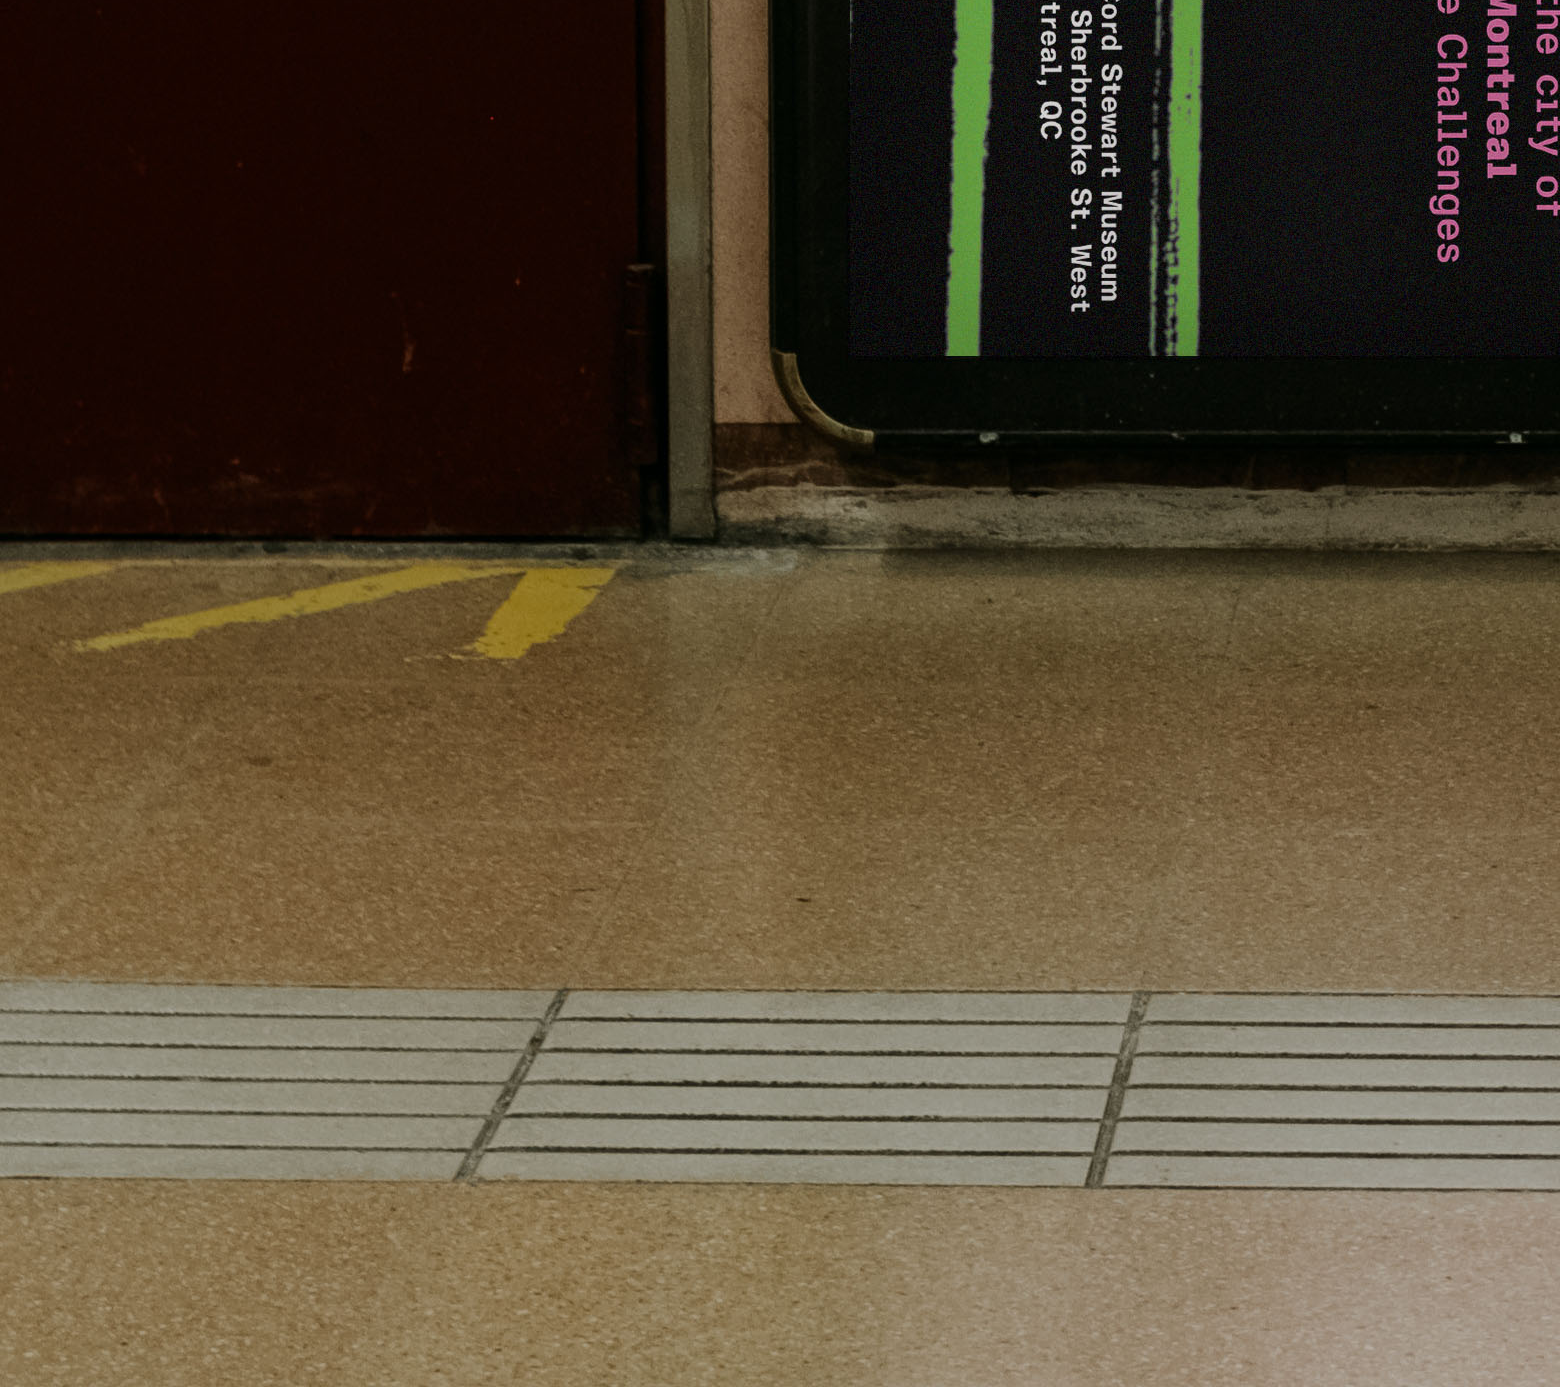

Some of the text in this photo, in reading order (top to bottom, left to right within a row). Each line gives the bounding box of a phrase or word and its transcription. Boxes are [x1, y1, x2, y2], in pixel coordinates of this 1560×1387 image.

[1037, 100, 1064, 140] QC
[1069, 10, 1094, 176] Sherbrooke
[1100, 63, 1124, 178] Stewart
[1429, 35, 1470, 263] Challenges
[1069, 188, 1094, 230] St.
[1100, 191, 1124, 302] Museum
[1069, 244, 1094, 313] West
